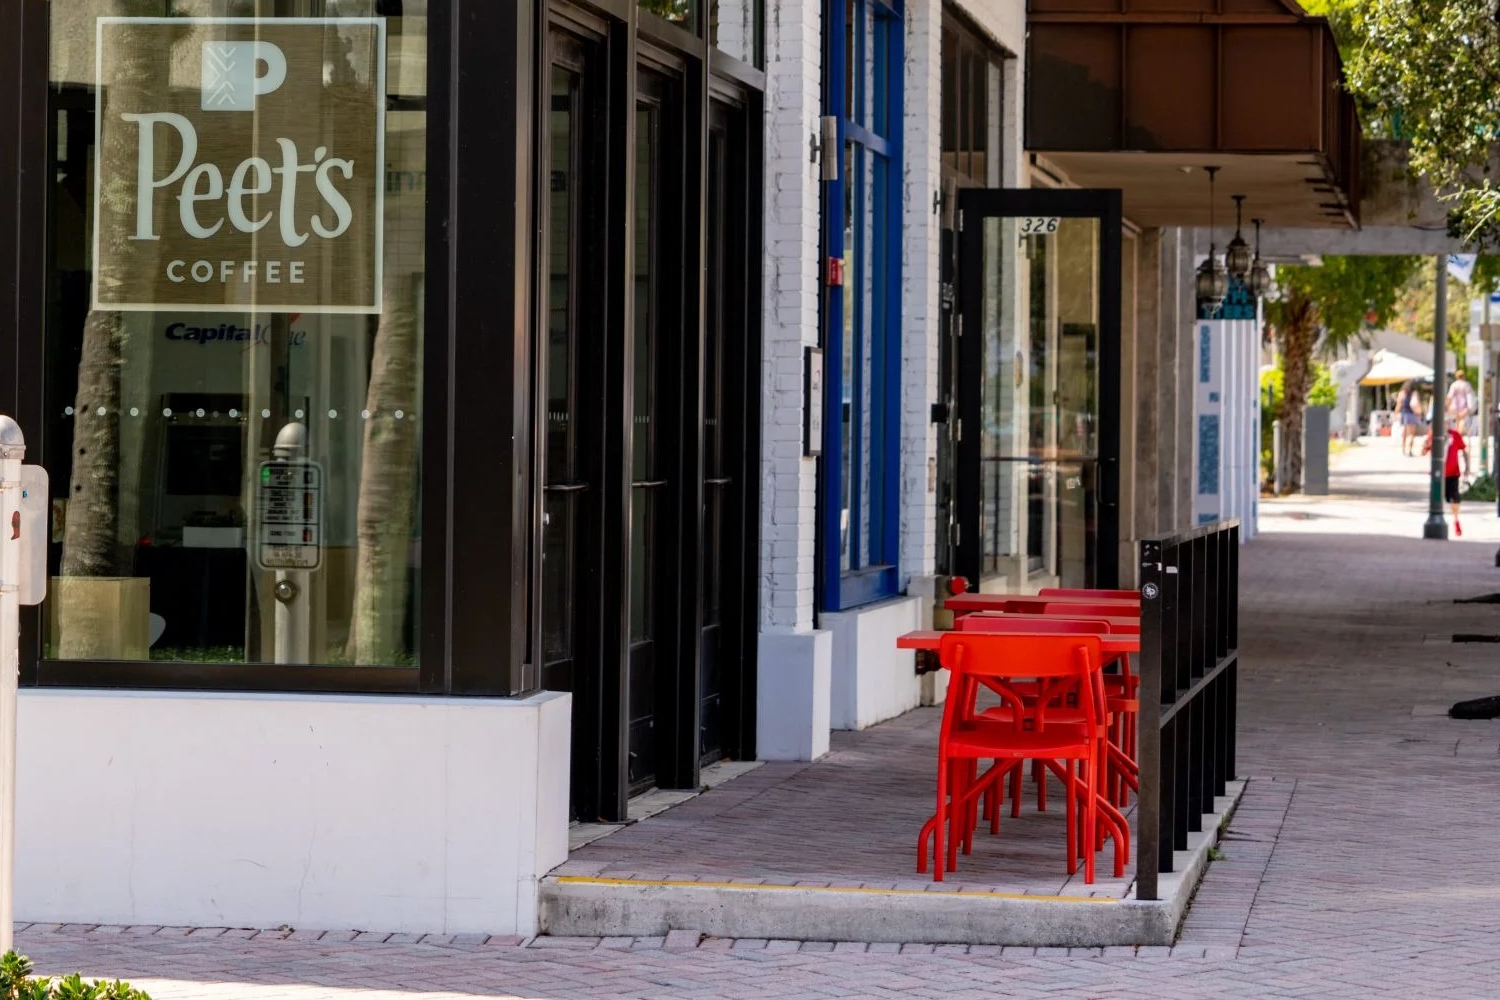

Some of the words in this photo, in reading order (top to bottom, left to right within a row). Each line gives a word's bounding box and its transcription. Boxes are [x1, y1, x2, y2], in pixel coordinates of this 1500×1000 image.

[120, 112, 355, 247] Peet's
[1021, 218, 1058, 232] 326
[166, 259, 306, 283] COFFEE
